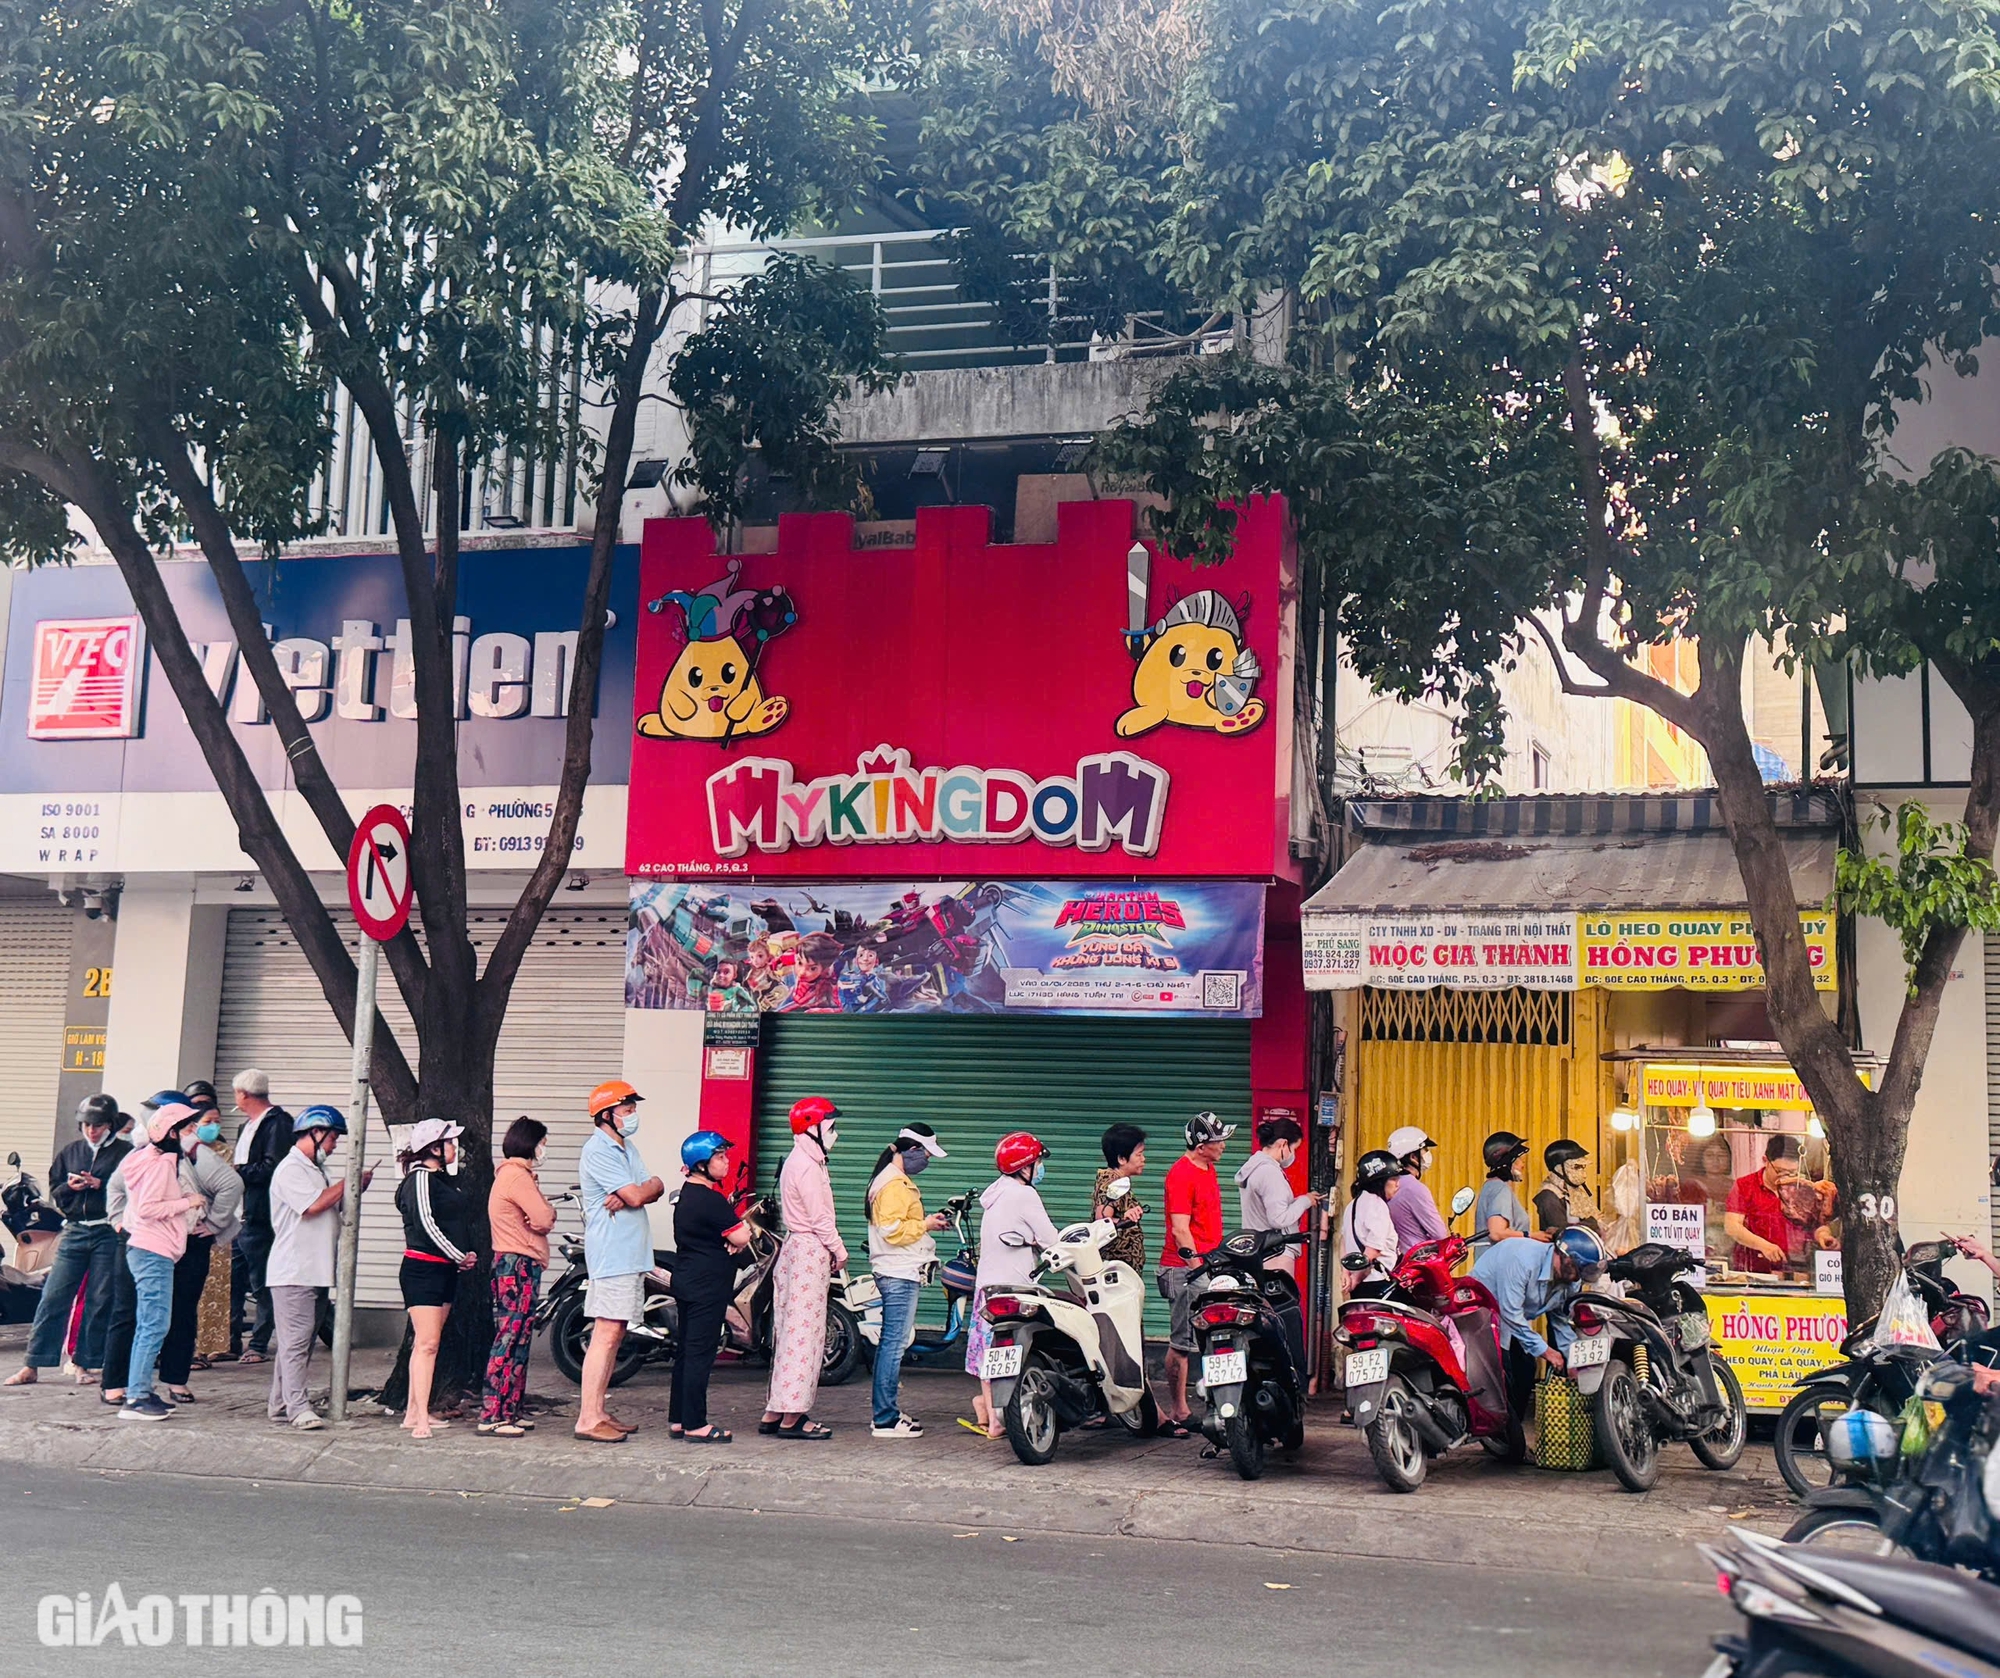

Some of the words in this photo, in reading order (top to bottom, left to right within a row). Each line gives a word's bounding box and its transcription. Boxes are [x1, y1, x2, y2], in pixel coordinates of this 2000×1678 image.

[46, 630, 129, 671] VTEC
[42, 804, 61, 816] ISO
[66, 804, 100, 816] 9001
[711, 758, 1158, 849] MYKINGDOM
[41, 826, 56, 839] SA
[63, 826, 99, 839] 8000
[499, 837, 531, 851] 0913
[639, 863, 651, 873] 62
[653, 863, 675, 873] CAO
[677, 859, 713, 874] THẮNG,
[1054, 900, 1186, 930] HEROES
[1369, 925, 1387, 937] CTY
[1390, 925, 1417, 937] TNHH
[1420, 925, 1434, 936] XD
[1444, 925, 1457, 936] DV
[1467, 925, 1501, 936] TRANG
[1504, 922, 1521, 936] TRÍ
[1524, 924, 1542, 938] NỘI
[1545, 920, 1571, 936] THẤT
[1586, 920, 1611, 936] LÒ
[1619, 923, 1660, 935] HEO
[1668, 922, 1722, 936] QUAY
[1803, 919, 1827, 936] UÝ
[1317, 937, 1335, 949] PHÚ
[1337, 939, 1360, 949] SANG
[1304, 949, 1360, 958] 0943.524.239
[1369, 940, 1427, 971] MỘC
[1432, 944, 1477, 966] GIA
[1482, 940, 1572, 966] THÀNH
[1587, 937, 1679, 967] HỒNG
[1102, 953, 1142, 968] LONG
[1304, 959, 1360, 969] 0937.371.327
[1407, 976, 1425, 984] CAO
[1482, 975, 1498, 984] Q.3
[1523, 975, 1573, 983] 3818.1468
[1585, 975, 1602, 983] ĐC:
[1627, 975, 1647, 984] CAO
[1712, 975, 1728, 984] Q.3
[1647, 1079, 1664, 1095] HEO
[1708, 1080, 1729, 1099] QUAY
[1753, 1082, 1775, 1099] XANH
[1651, 1205, 1668, 1221] CÓ
[1672, 1206, 1697, 1221] BÁN
[1860, 1193, 1894, 1220] 30
[1650, 1223, 1663, 1238] GÓC
[1673, 1226, 1683, 1242] VỊT
[1684, 1226, 1701, 1242] QUAY
[1827, 1256, 1841, 1268] CÓ
[1819, 1272, 1832, 1283] GIÒ
[1721, 1301, 1779, 1341] HỒNG
[988, 1348, 1016, 1363] 50-N2
[1573, 1350, 1604, 1365] 3392
[1725, 1356, 1745, 1364] HEO
[1780, 1356, 1793, 1365] GÀ
[985, 1361, 1017, 1376] 162.67
[1349, 1366, 1384, 1384] 075.72
